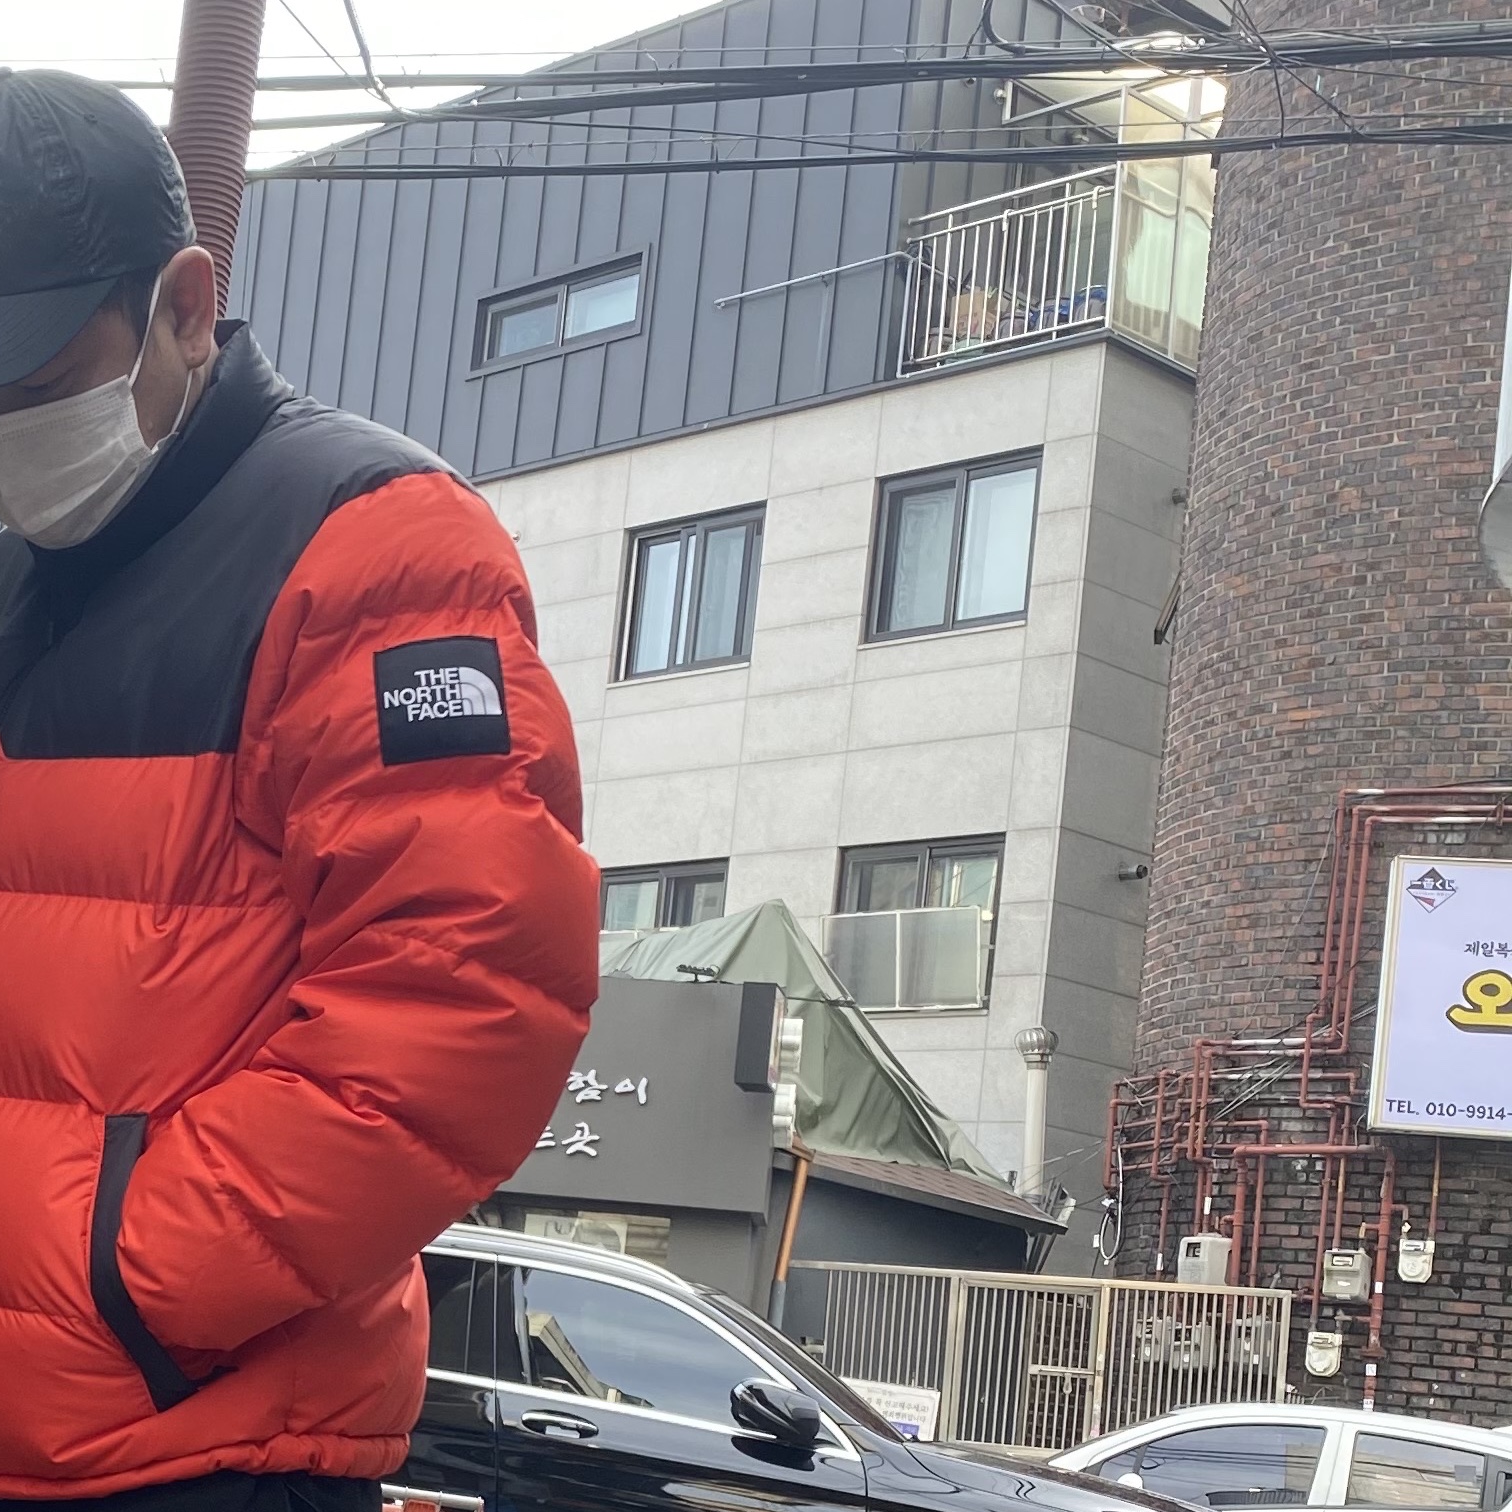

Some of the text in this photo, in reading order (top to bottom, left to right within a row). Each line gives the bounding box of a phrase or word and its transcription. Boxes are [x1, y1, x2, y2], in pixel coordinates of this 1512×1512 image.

[414, 667, 460, 686] THE
[383, 684, 461, 709] NORTH
[407, 700, 464, 722] FACE
[1464, 940, 1512, 959] 제일복
[1386, 1099, 1420, 1116] TEL.
